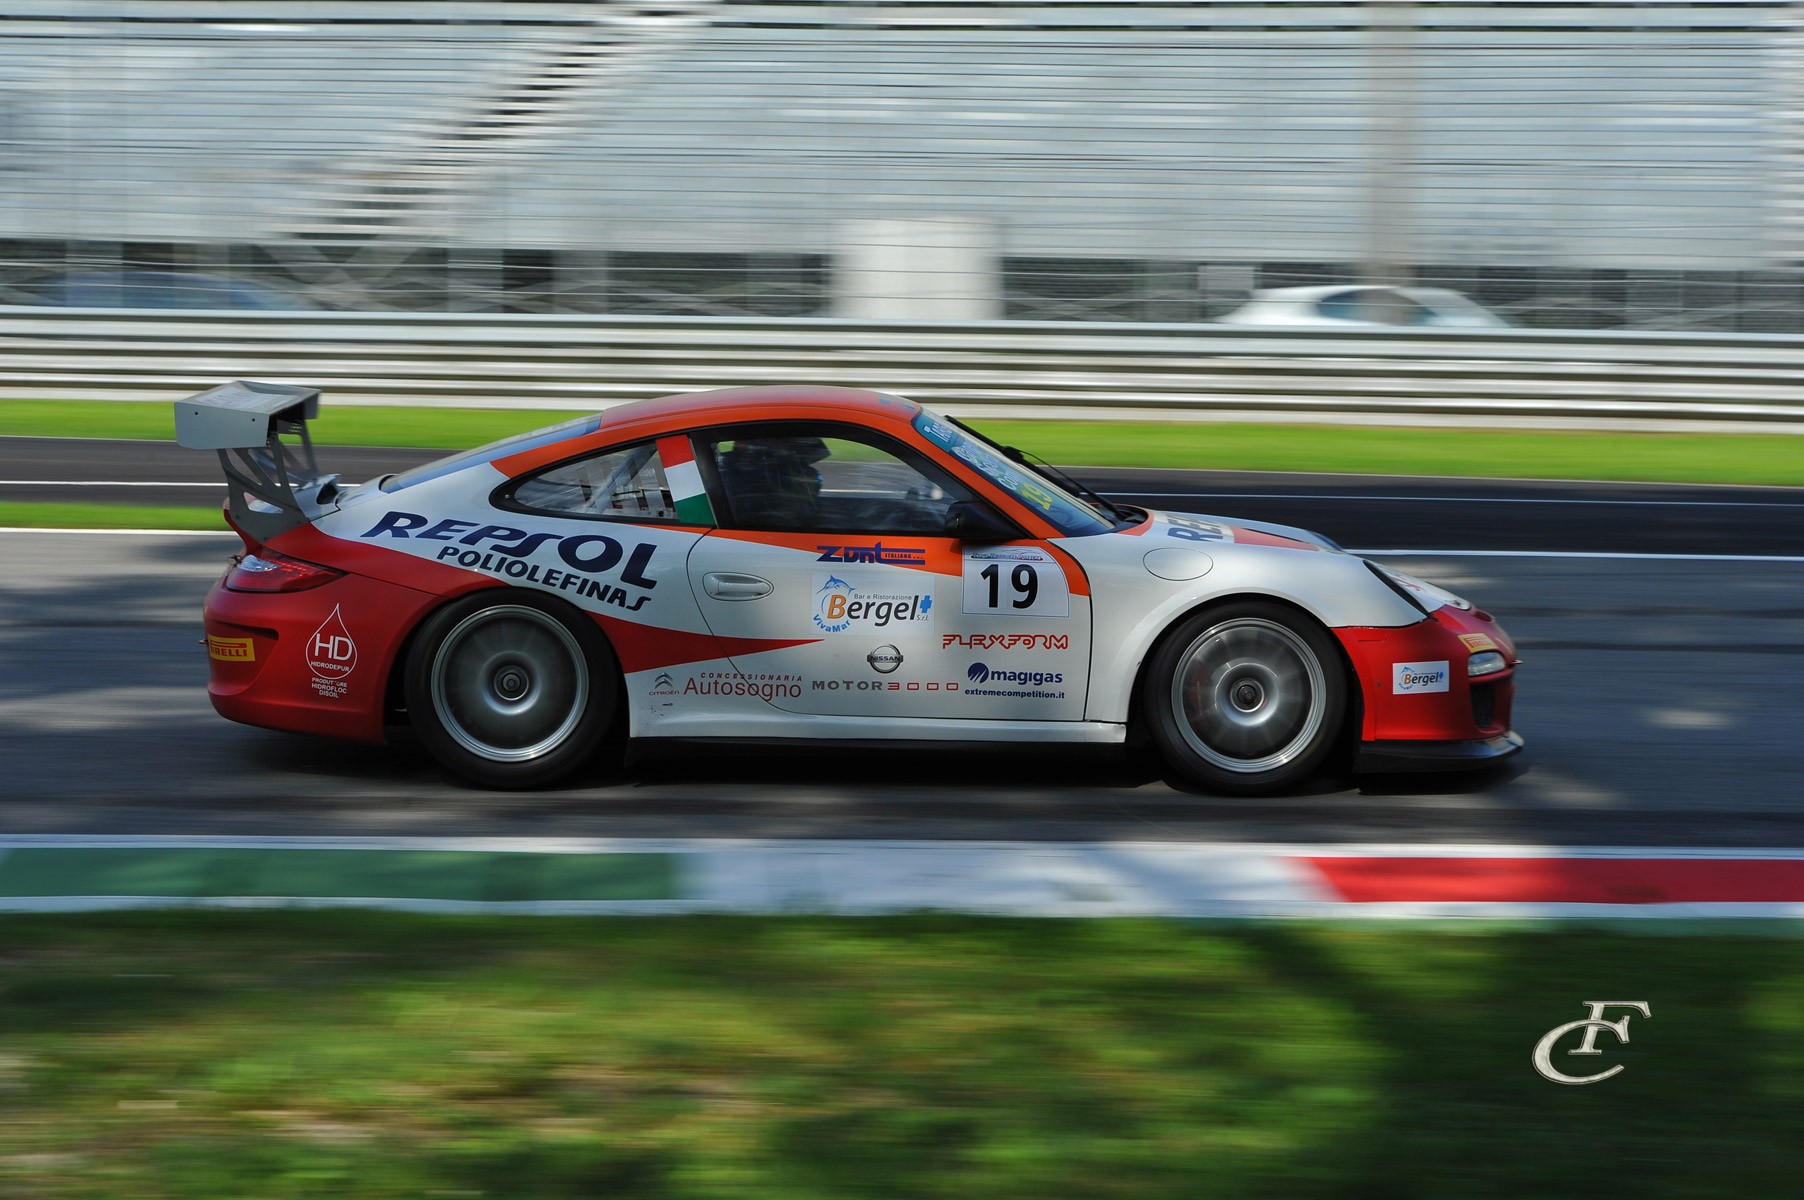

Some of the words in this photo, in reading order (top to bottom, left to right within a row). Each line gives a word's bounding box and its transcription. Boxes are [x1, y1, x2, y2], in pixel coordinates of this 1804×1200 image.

[360, 511, 658, 590] REPSOL
[436, 546, 652, 611] POLIOLEFINAS
[980, 564, 1038, 609] 19
[827, 594, 919, 627] Bergel
[813, 614, 851, 633] VivaMar
[314, 634, 352, 661] HD
[943, 634, 1068, 649] FLEXFORM
[311, 660, 350, 672] HIDRODEPUR
[700, 672, 802, 682] CONCESSIONARIA
[991, 669, 1063, 685] magigas
[1403, 671, 1439, 687] Bergel
[312, 683, 347, 694] HIDROFLOC
[319, 690, 339, 698] DISOIL
[683, 677, 801, 702] Autosogno
[965, 688, 1065, 699] extremecompetition.it
